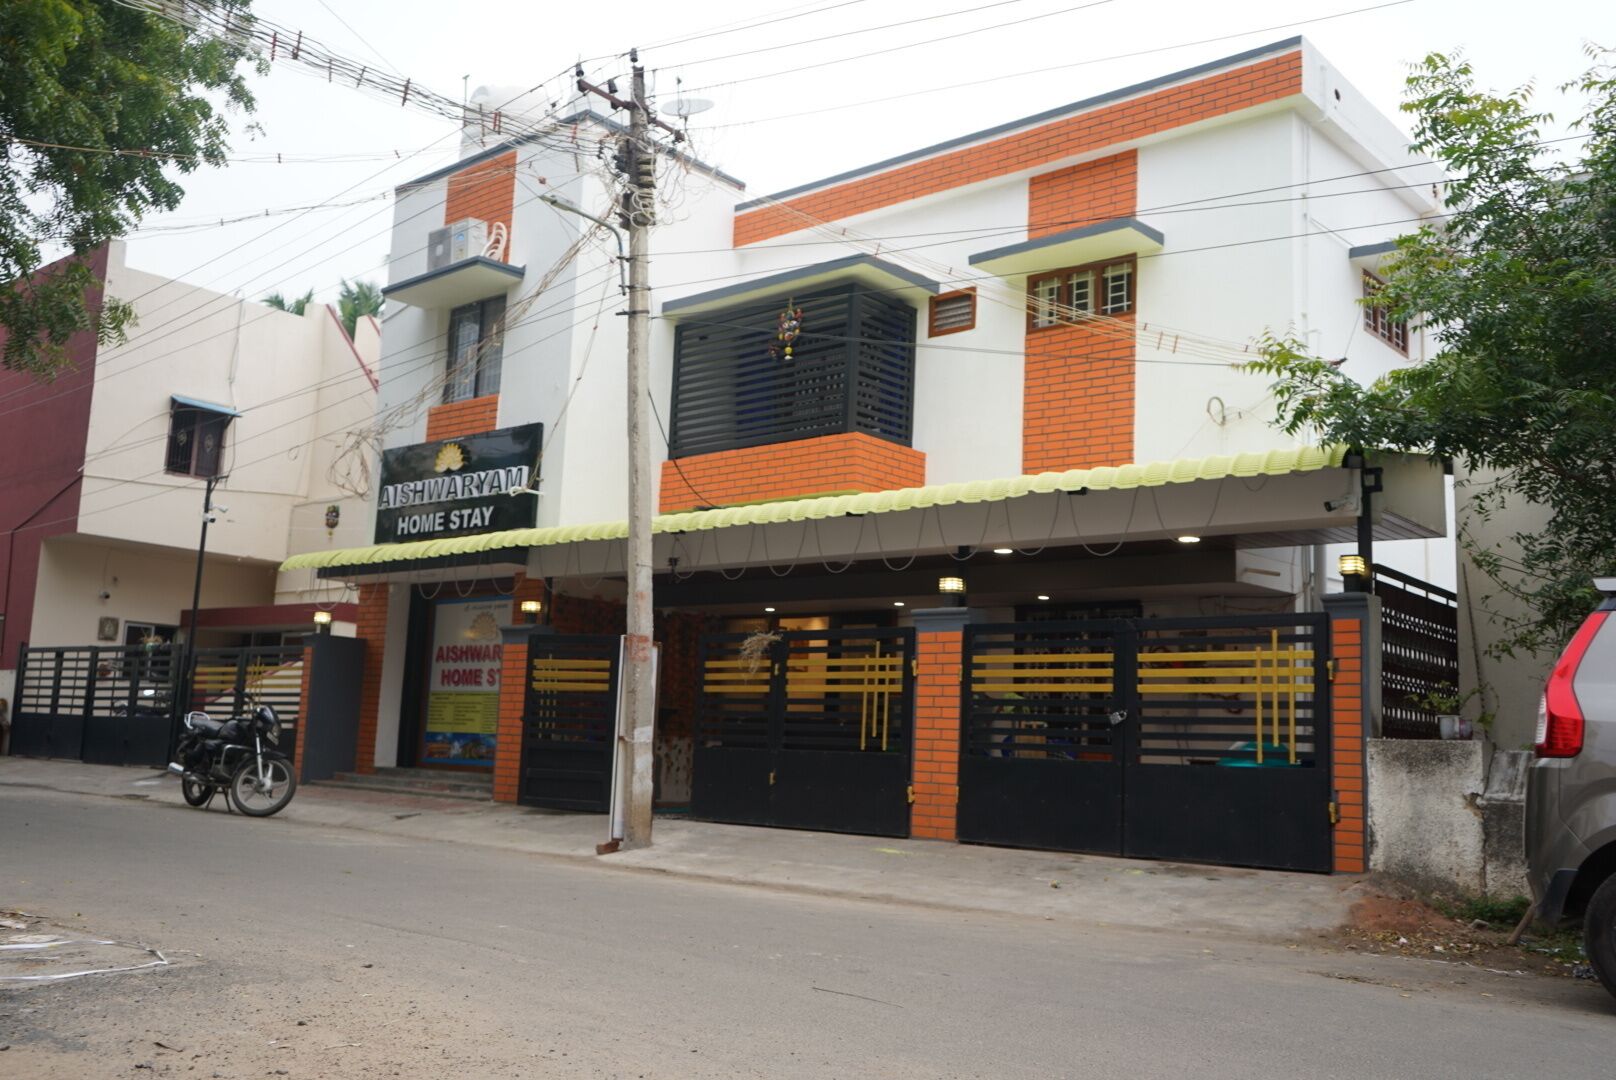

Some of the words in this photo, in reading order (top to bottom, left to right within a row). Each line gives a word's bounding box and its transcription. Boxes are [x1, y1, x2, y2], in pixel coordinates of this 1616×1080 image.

[378, 465, 529, 510] AISHWARYAM
[397, 512, 445, 536] HOME
[449, 506, 495, 530] STAY
[440, 668, 483, 687] HOME
